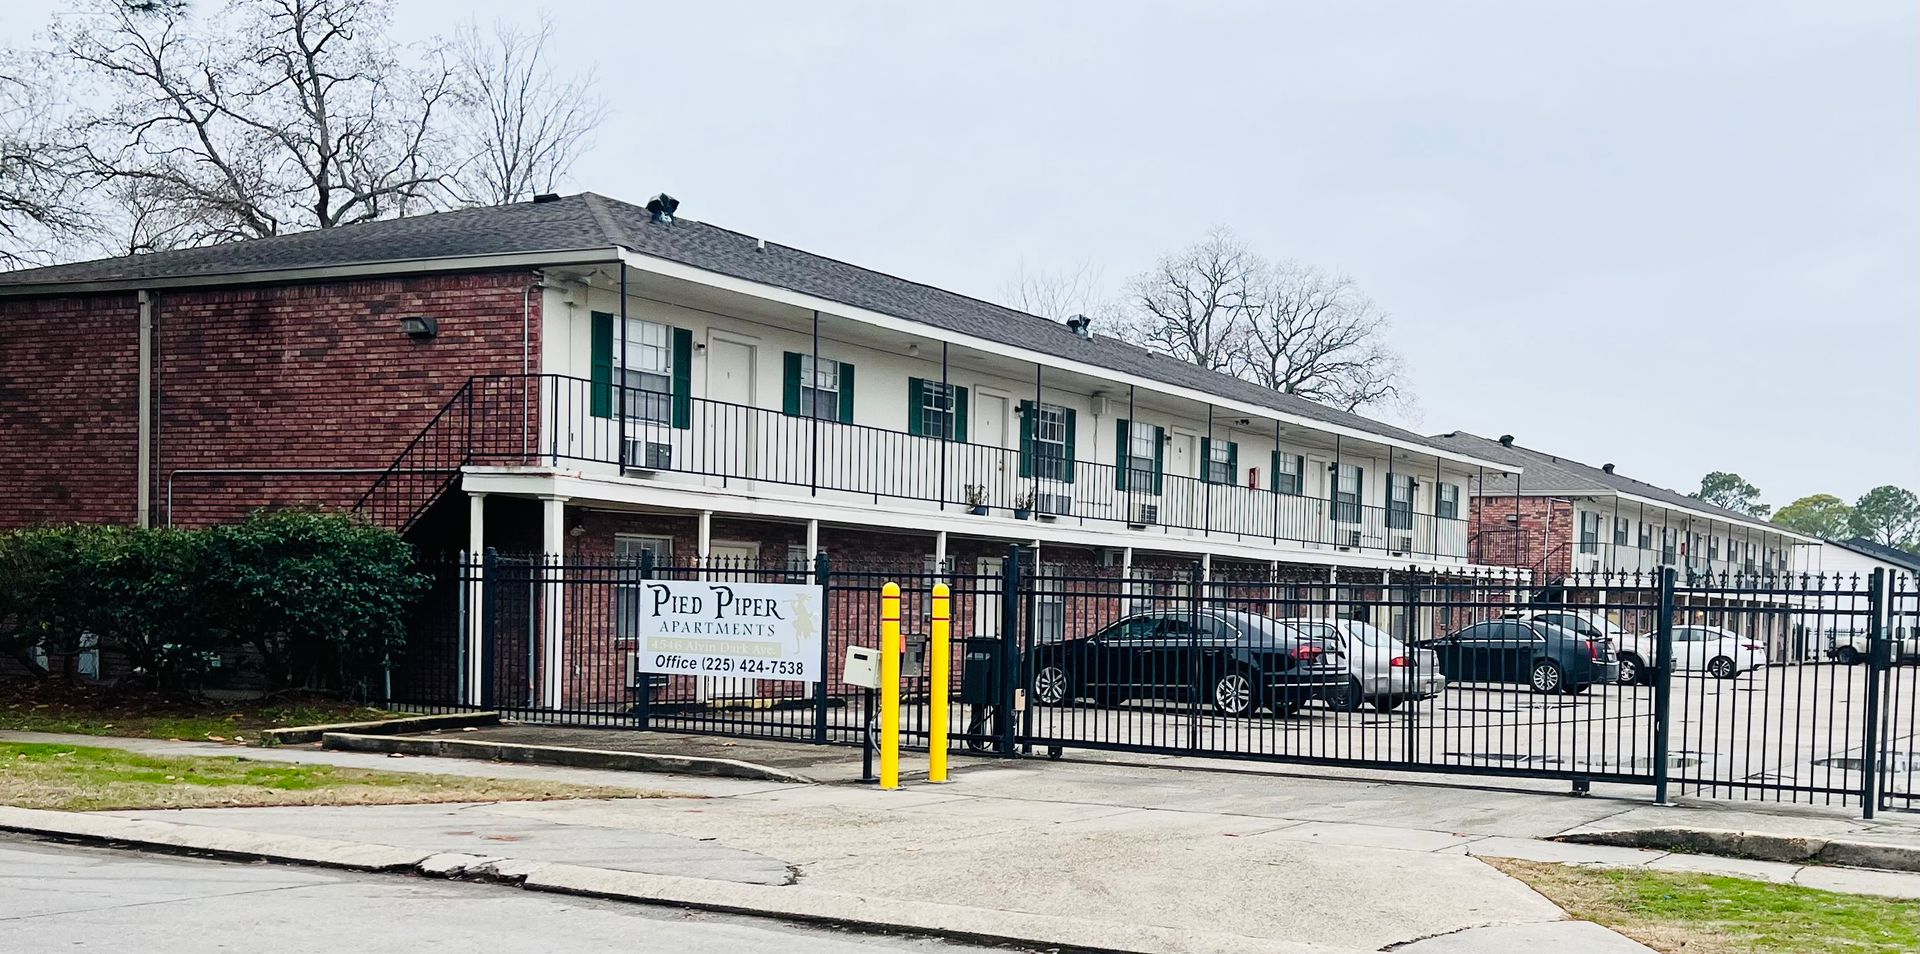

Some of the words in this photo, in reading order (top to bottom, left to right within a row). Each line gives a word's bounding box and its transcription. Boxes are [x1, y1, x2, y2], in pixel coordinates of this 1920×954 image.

[646, 584, 703, 617] PIED
[709, 585, 785, 620] PIPER
[659, 620, 775, 637] APARTMENTS
[652, 639, 682, 651] 4546
[685, 640, 717, 653] Alvin
[720, 642, 749, 654] Dark
[751, 644, 776, 656] Ave.
[655, 654, 698, 670] Office
[701, 657, 735, 672] (225)
[739, 659, 804, 675] 424-7538
